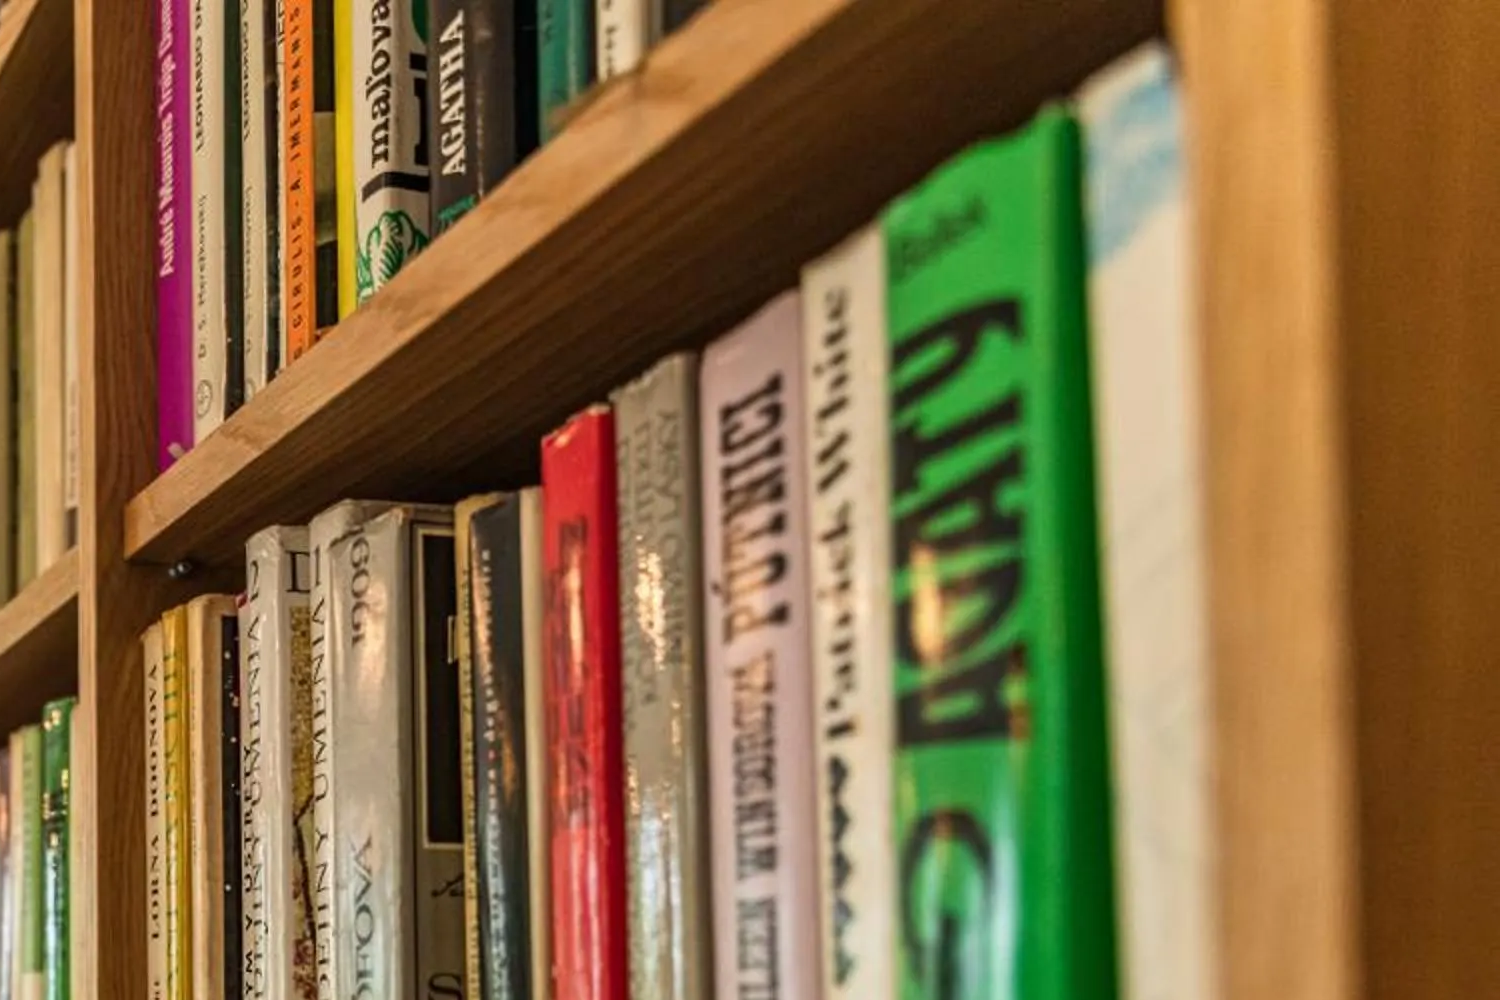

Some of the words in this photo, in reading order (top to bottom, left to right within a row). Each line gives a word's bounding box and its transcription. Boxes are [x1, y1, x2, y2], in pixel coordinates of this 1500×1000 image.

[158, 112, 175, 212] Maurois
[194, 34, 205, 153] LEONARDO
[287, 6, 302, 163] IMERMANIS
[438, 9, 468, 176] AGATHA
[158, 208, 175, 278] André
[289, 215, 304, 330] CIRULIS
[812, 286, 853, 496] White
[710, 371, 790, 646] PÚTNICI
[311, 596, 330, 802] UMENIA
[814, 501, 858, 741] Patrick
[247, 613, 263, 807] UMENIA
[148, 833, 161, 939] LORNA
